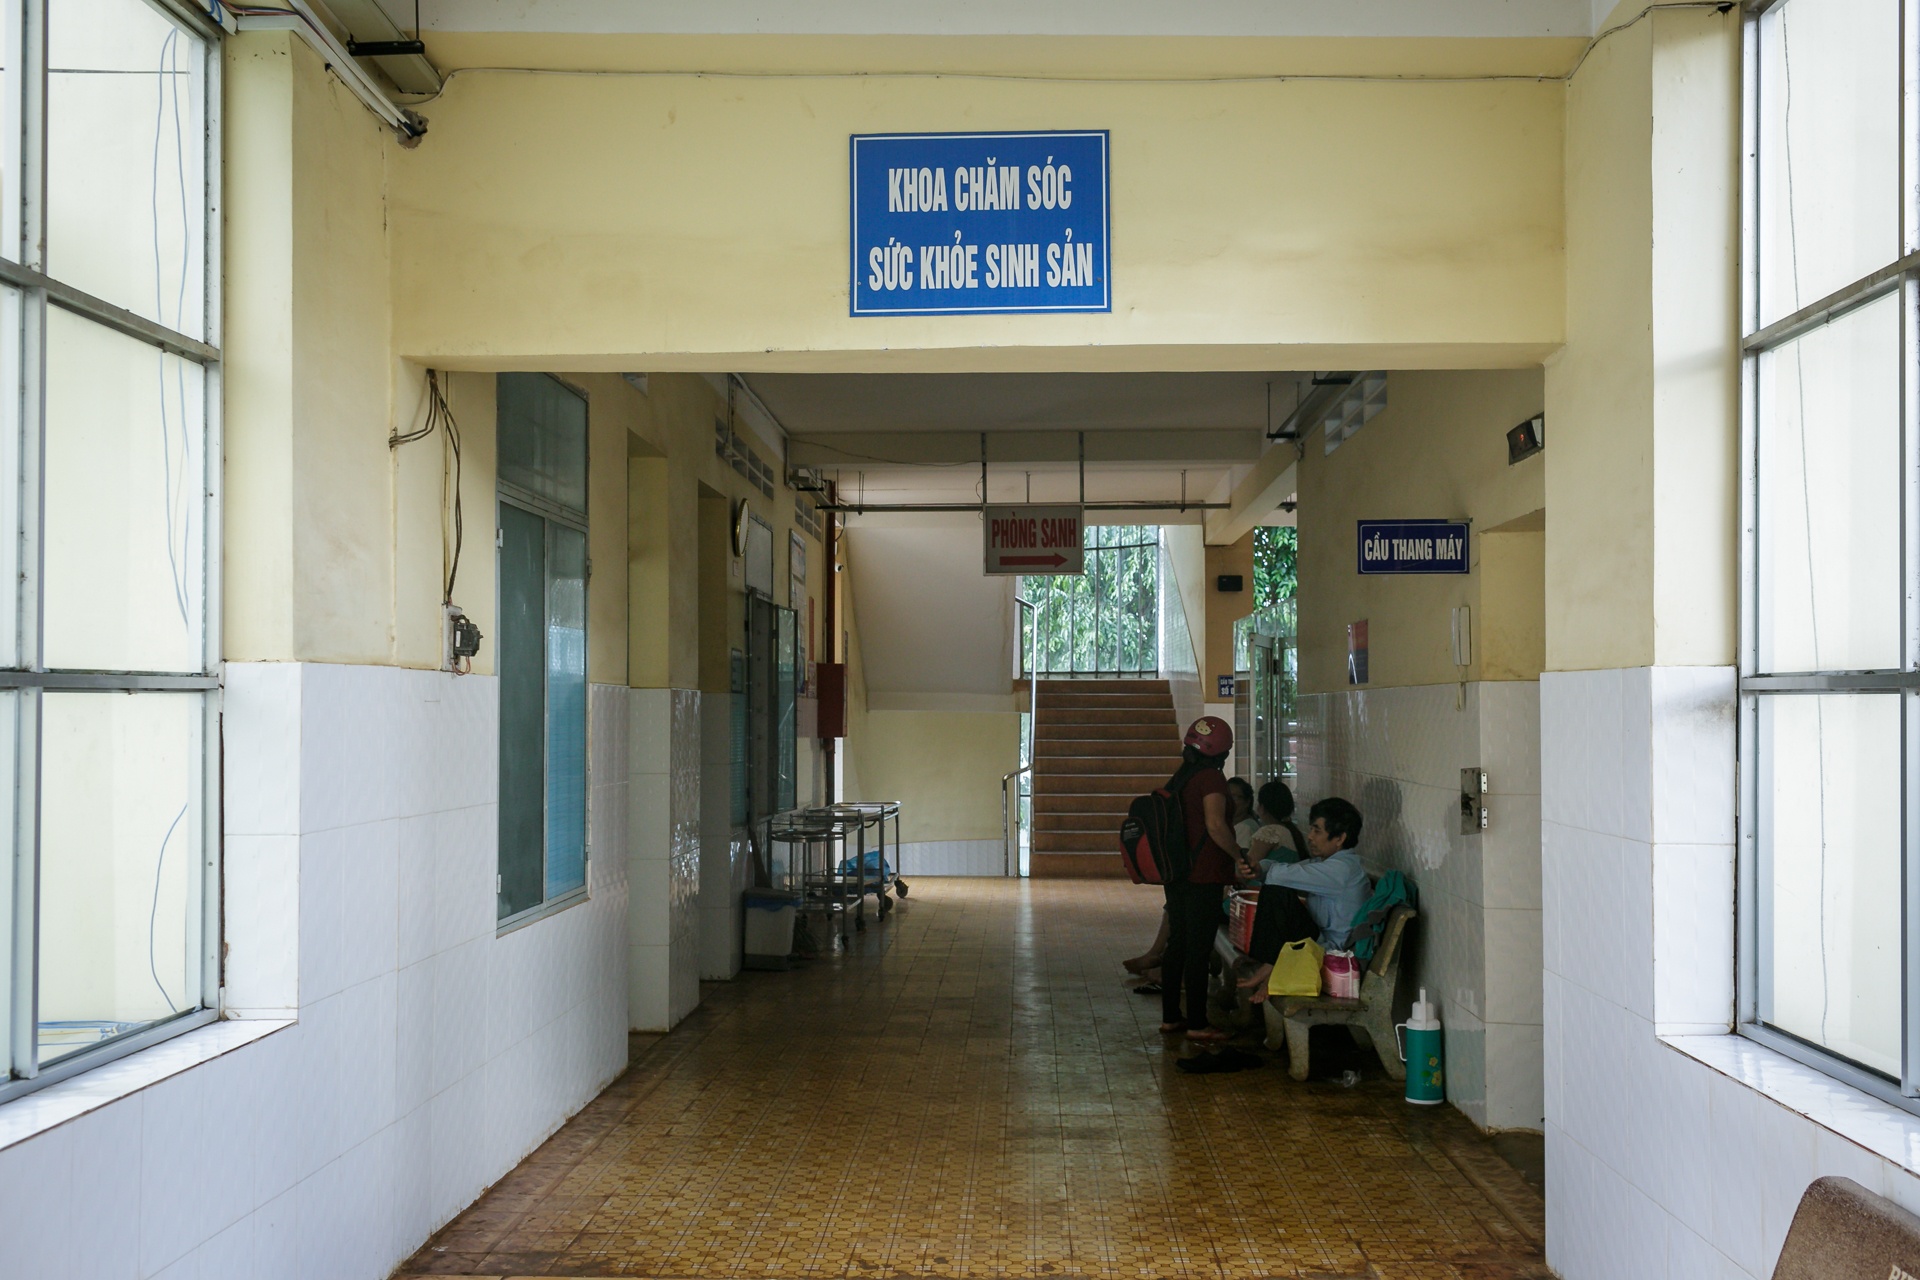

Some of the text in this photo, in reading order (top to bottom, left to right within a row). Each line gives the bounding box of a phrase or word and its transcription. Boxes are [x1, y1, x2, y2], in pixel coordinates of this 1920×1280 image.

[888, 155, 1072, 213] KHOA CHĂM SÓC
[868, 227, 1093, 292] SỨC KHỎE SINH SẢN
[991, 511, 1077, 549] PHÒNG SANH
[1364, 531, 1463, 561] CẦU THANG MÁY
